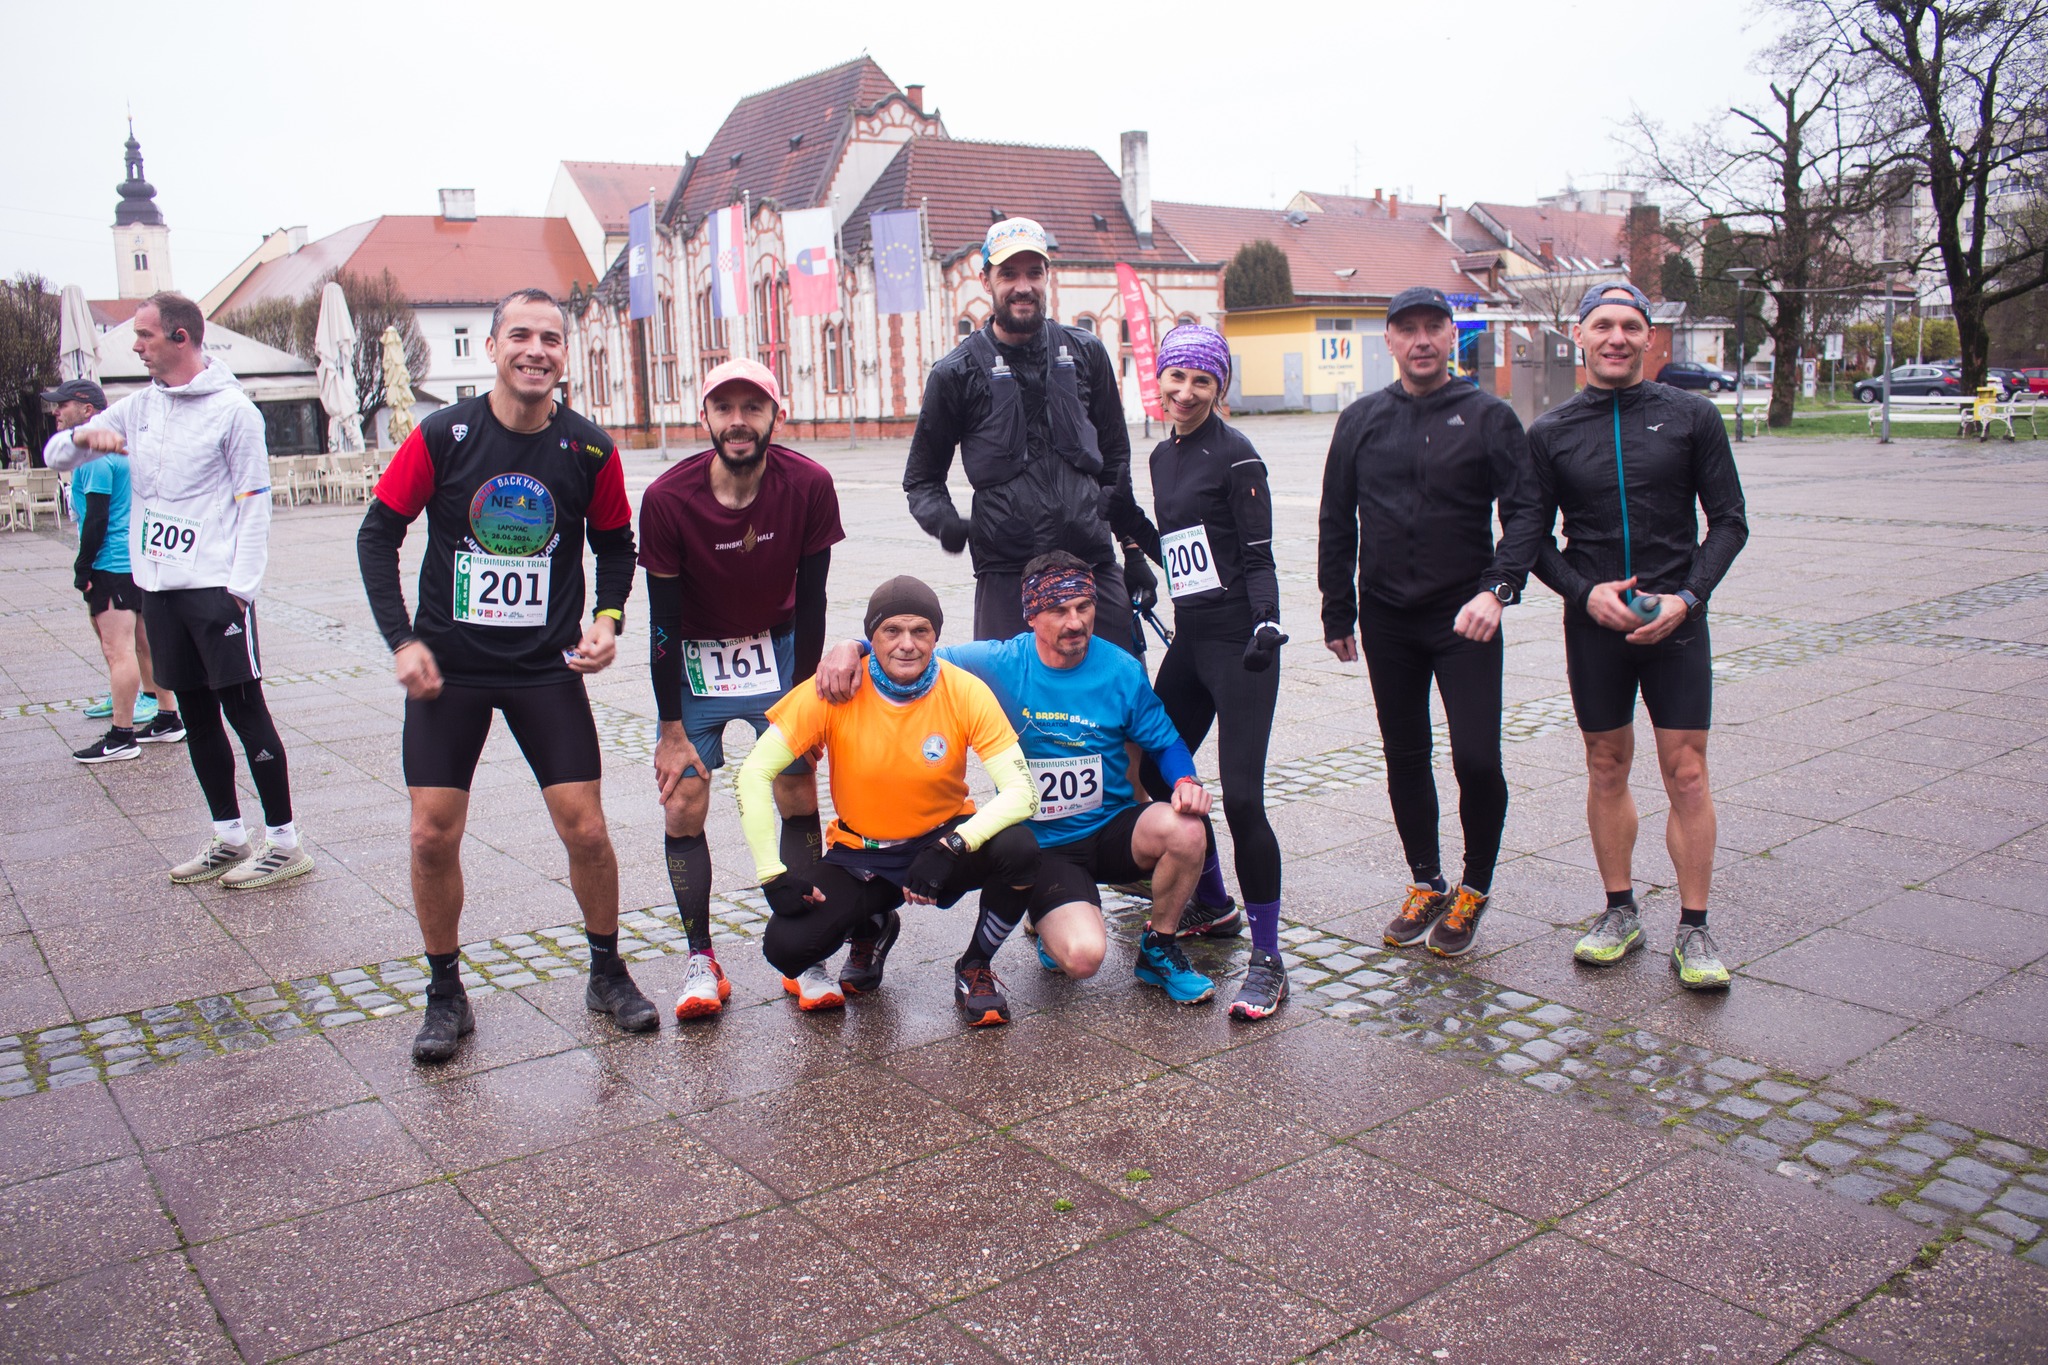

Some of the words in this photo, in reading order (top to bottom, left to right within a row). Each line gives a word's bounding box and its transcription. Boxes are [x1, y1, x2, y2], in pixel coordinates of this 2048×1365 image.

[472, 483, 497, 519] CROATIA
[497, 476, 545, 497] BACKYARD
[497, 524, 528, 532] LAPOVAC
[1187, 528, 1204, 538] TRIAL
[150, 521, 196, 554] 209
[715, 540, 743, 550] ZRINSKI
[757, 532, 775, 543] HALF
[494, 543, 529, 555] NAŠICE
[472, 556, 524, 568] MEĐIMURSKI
[527, 560, 549, 568] TRIAL
[1168, 540, 1208, 579] 200
[479, 570, 543, 607] 201
[710, 643, 772, 681] 161
[1035, 712, 1069, 721] BRDSKI
[1069, 715, 1080, 723] 85
[1013, 759, 1027, 772] BK
[1030, 759, 1078, 769] MEĐIMURSKI
[1080, 757, 1100, 766] TRIAL
[1039, 768, 1098, 802] 203
[735, 794, 745, 818] LIGA
